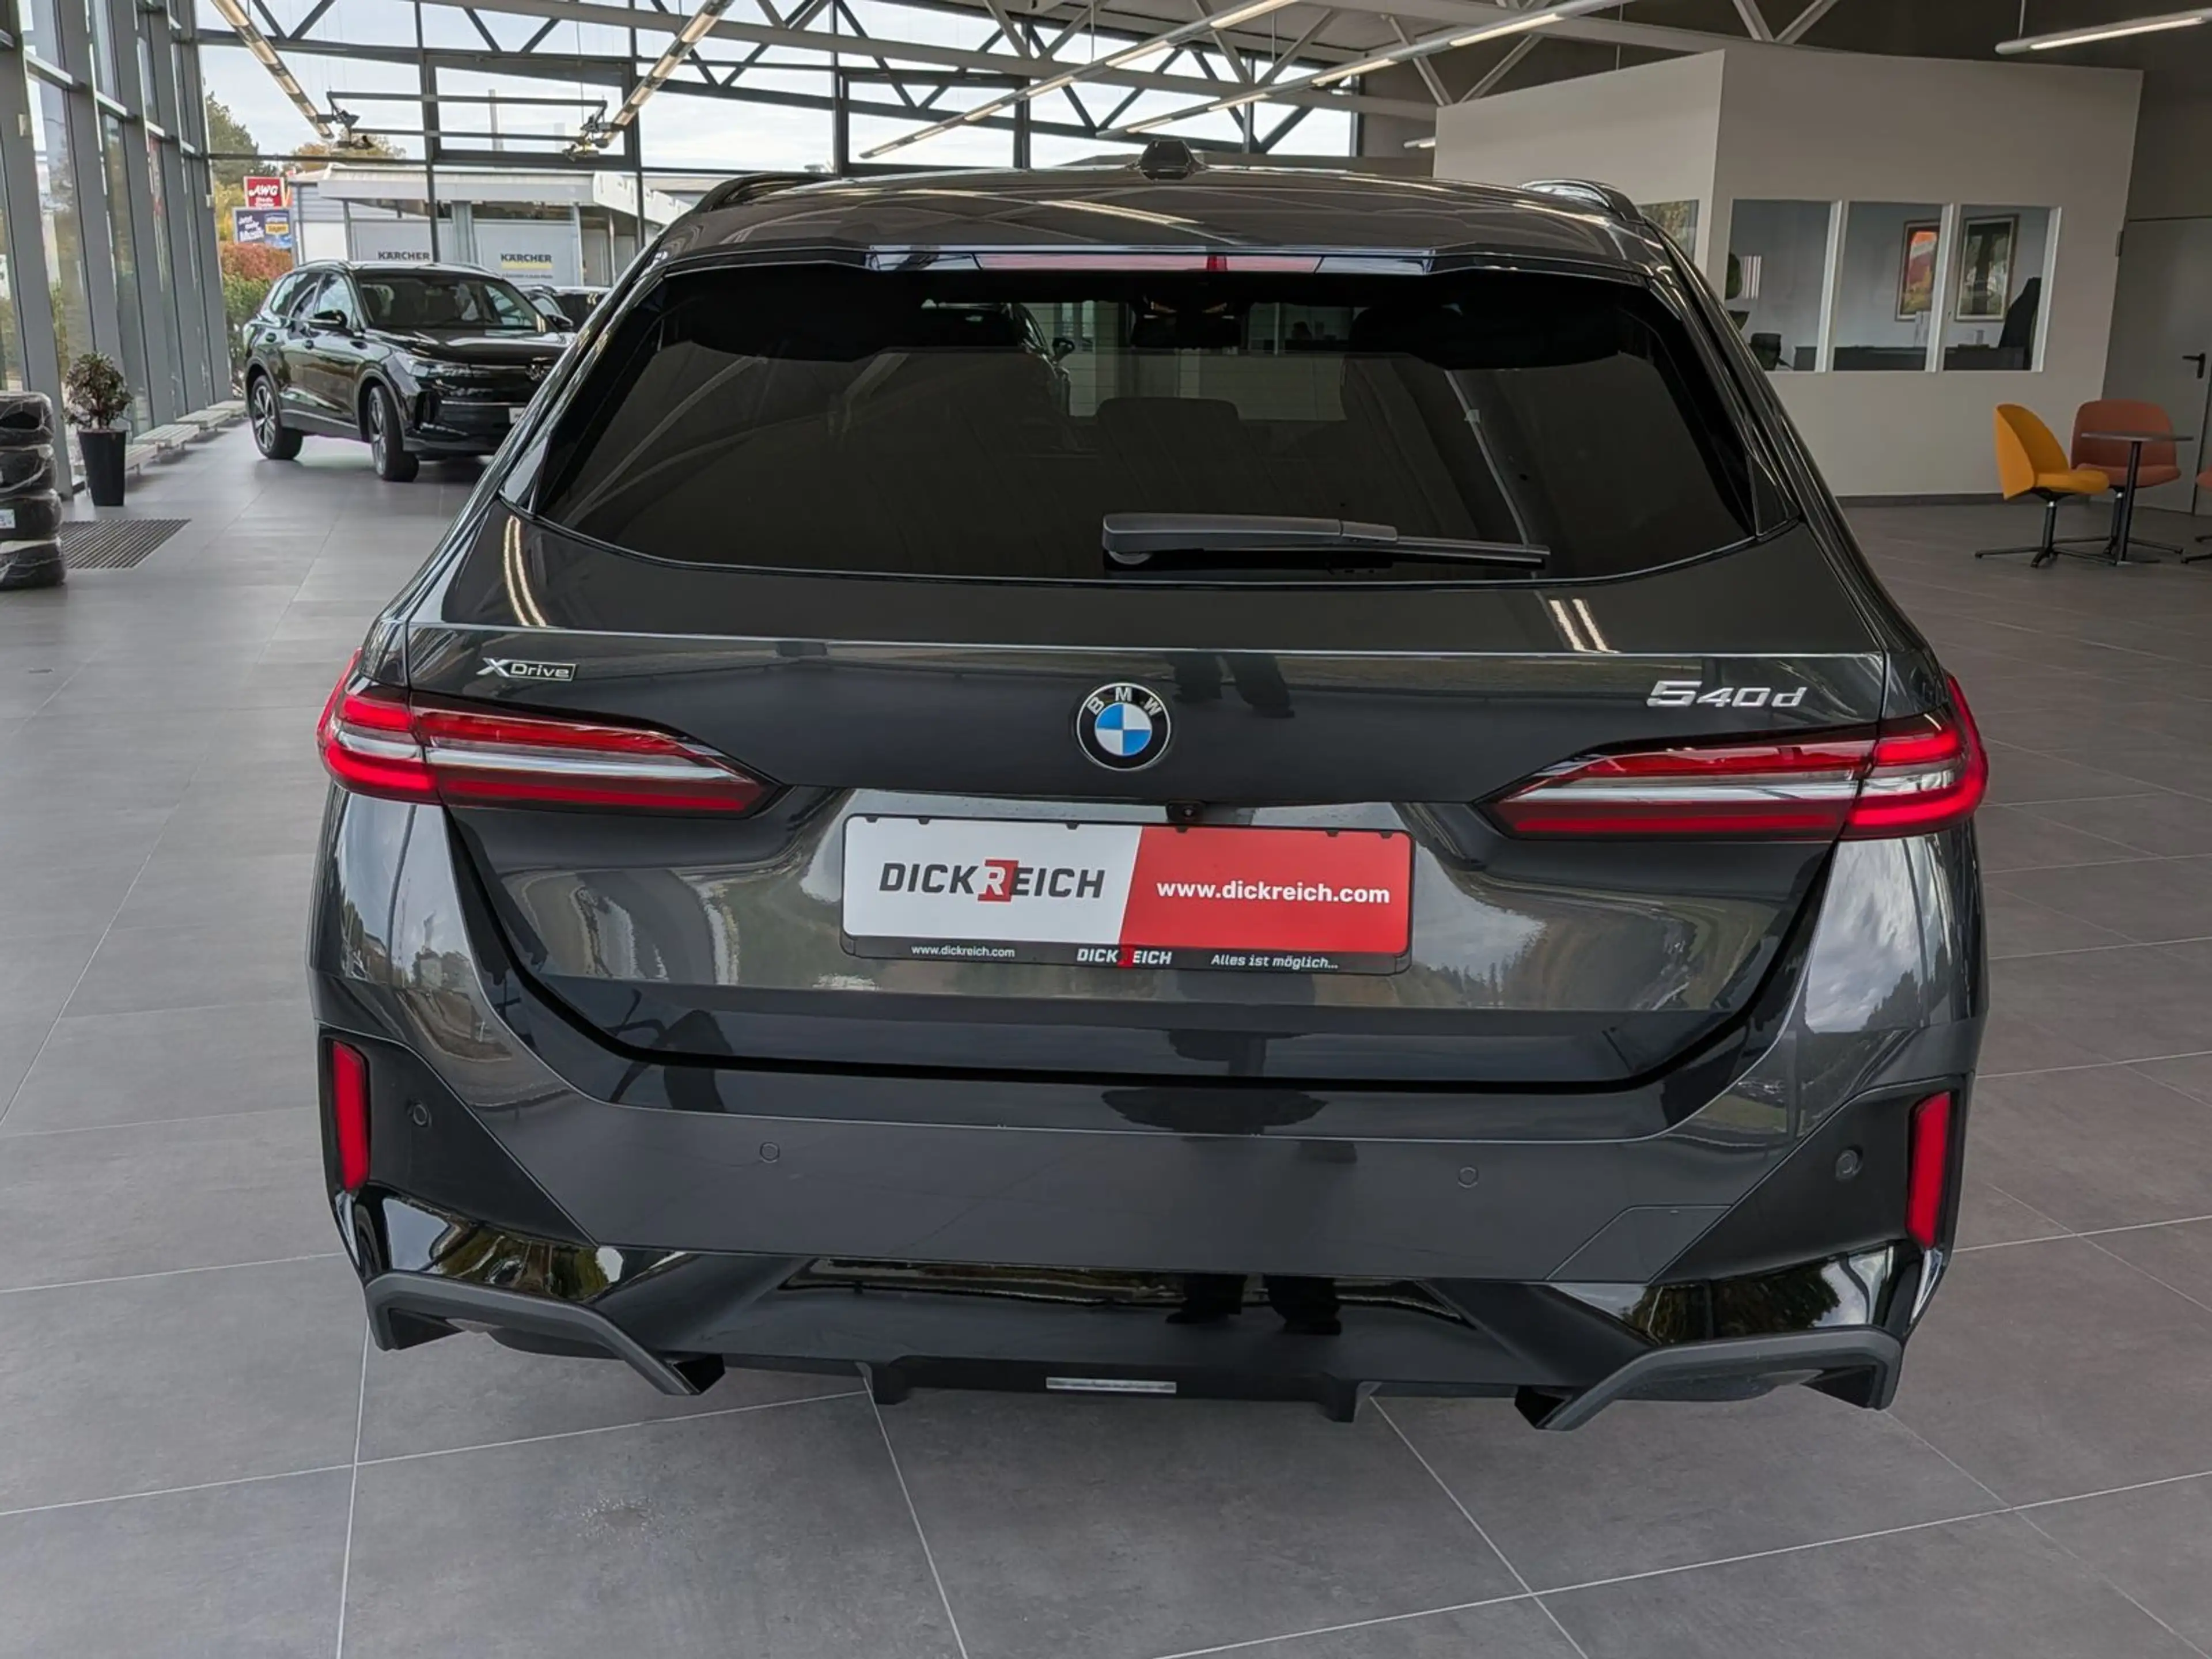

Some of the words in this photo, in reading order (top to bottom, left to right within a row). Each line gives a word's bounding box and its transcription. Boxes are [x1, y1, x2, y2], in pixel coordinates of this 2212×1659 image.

[249, 184, 279, 196] AWG
[1086, 687, 1162, 716] BMW
[1647, 680, 1808, 707] 540d
[879, 859, 1105, 902] DICKREICH
[1156, 880, 1390, 904] www.dickreich.com
[911, 945, 1016, 957] www.dickreich.com
[1076, 948, 1172, 965] DICKEICH
[1211, 954, 1245, 966] Alles
[1248, 954, 1269, 967] ist
